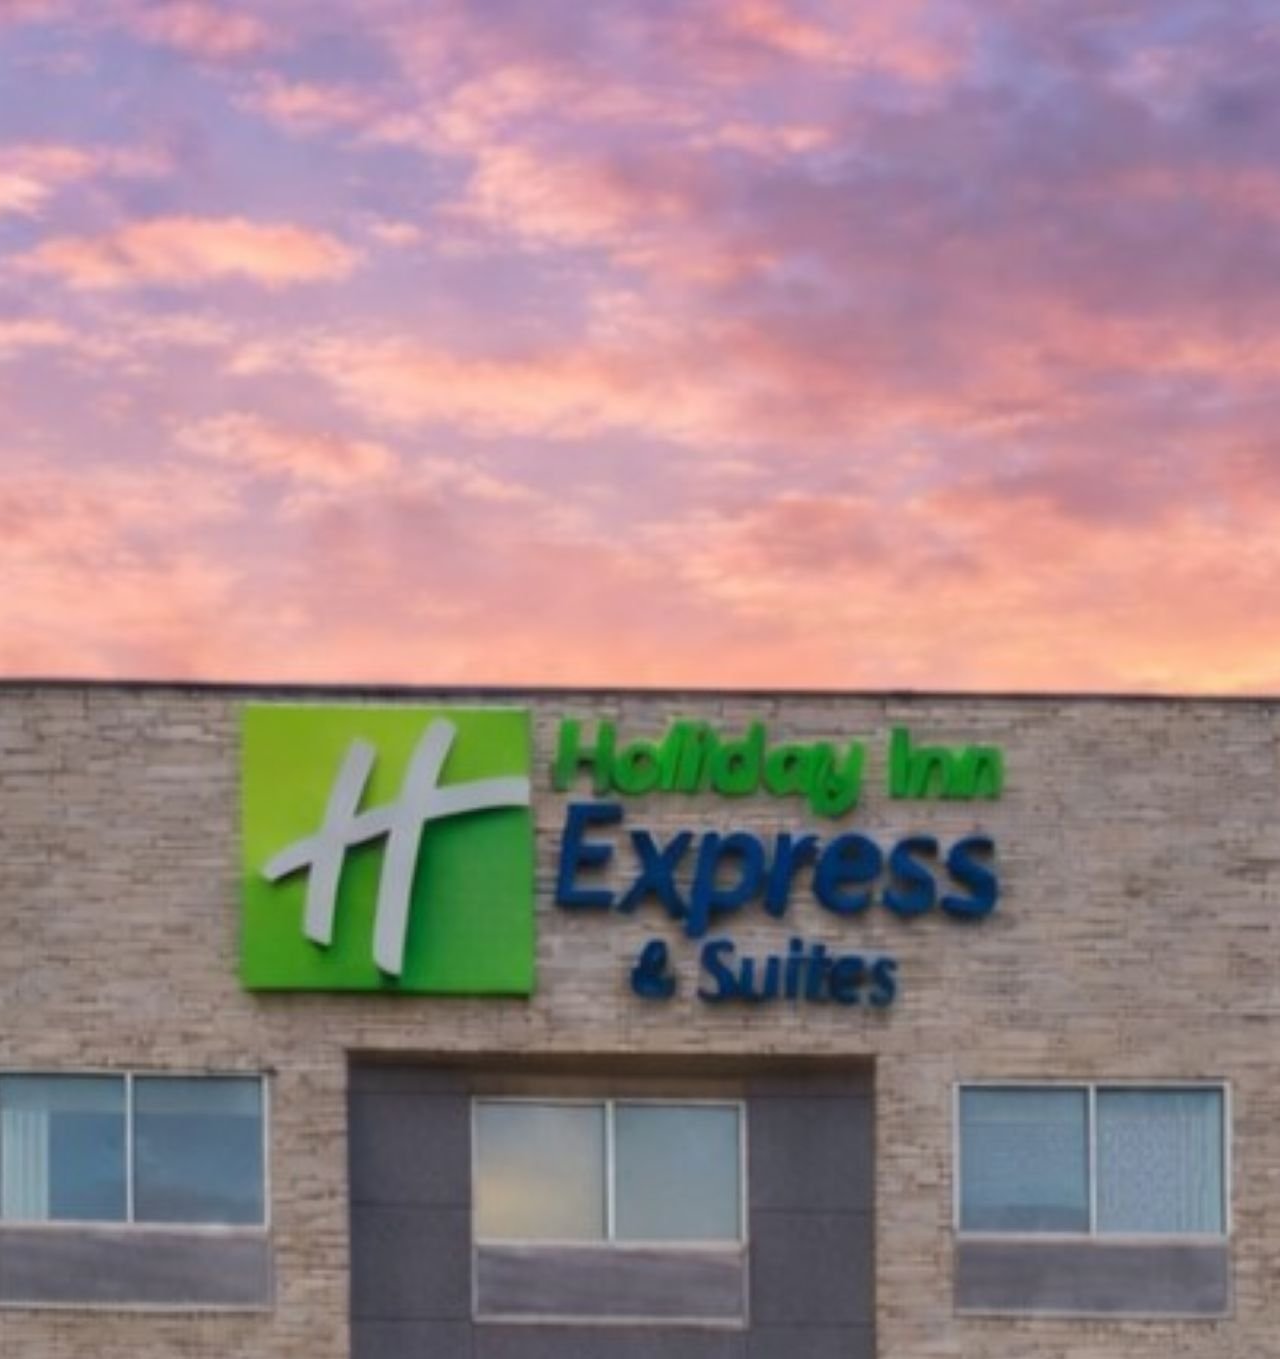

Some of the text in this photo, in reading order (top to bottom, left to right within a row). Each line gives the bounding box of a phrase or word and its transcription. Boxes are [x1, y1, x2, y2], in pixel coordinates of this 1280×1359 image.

[553, 716, 1004, 819] Holiday Inn
[555, 803, 1000, 939] Express
[630, 937, 899, 1007] & Suites
